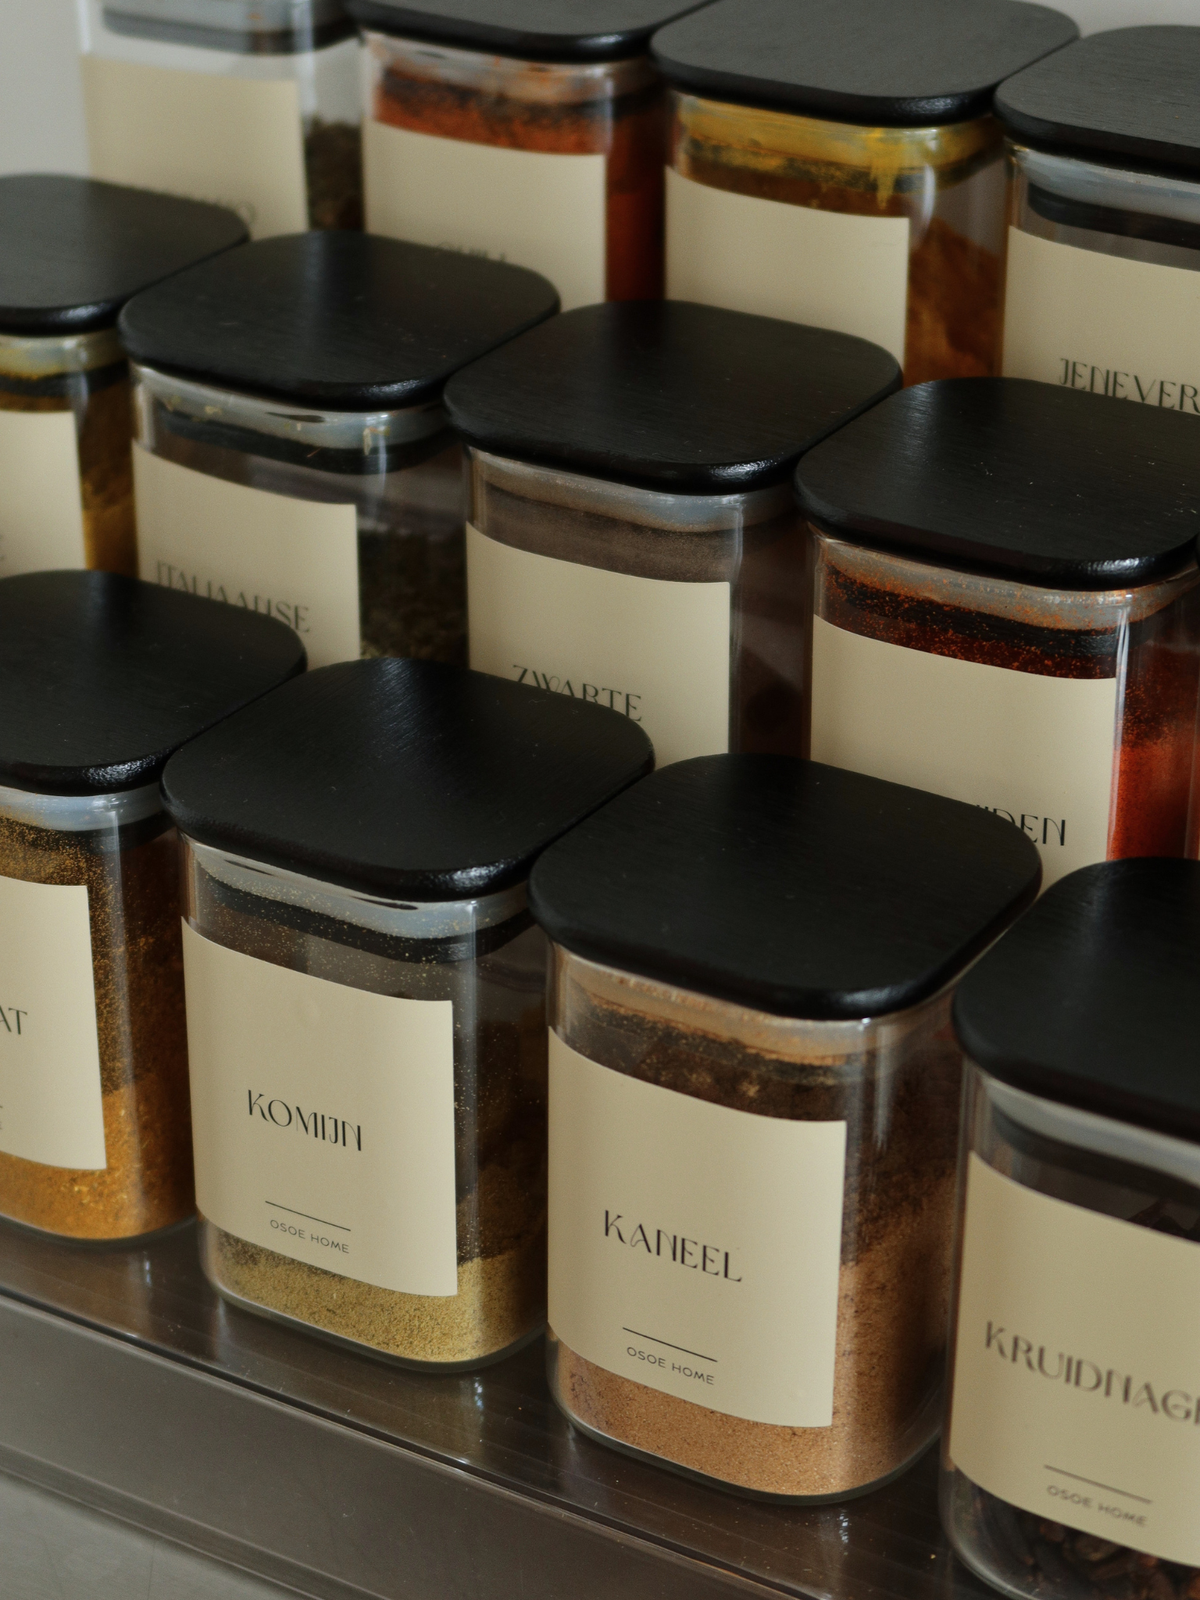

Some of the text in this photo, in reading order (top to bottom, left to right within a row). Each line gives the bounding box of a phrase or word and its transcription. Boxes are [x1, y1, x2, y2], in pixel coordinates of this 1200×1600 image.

[1060, 357, 1200, 414] JENEVER
[512, 664, 643, 722] ZWARTE
[248, 1089, 362, 1152] KOMIJN
[269, 1219, 350, 1254] OSOE HOME
[604, 1209, 743, 1283] KANEEL
[626, 1346, 715, 1386] OSOE HOME
[985, 1320, 1200, 1426] KRUIDNAG
[1046, 1484, 1148, 1526] OSOE HOME
